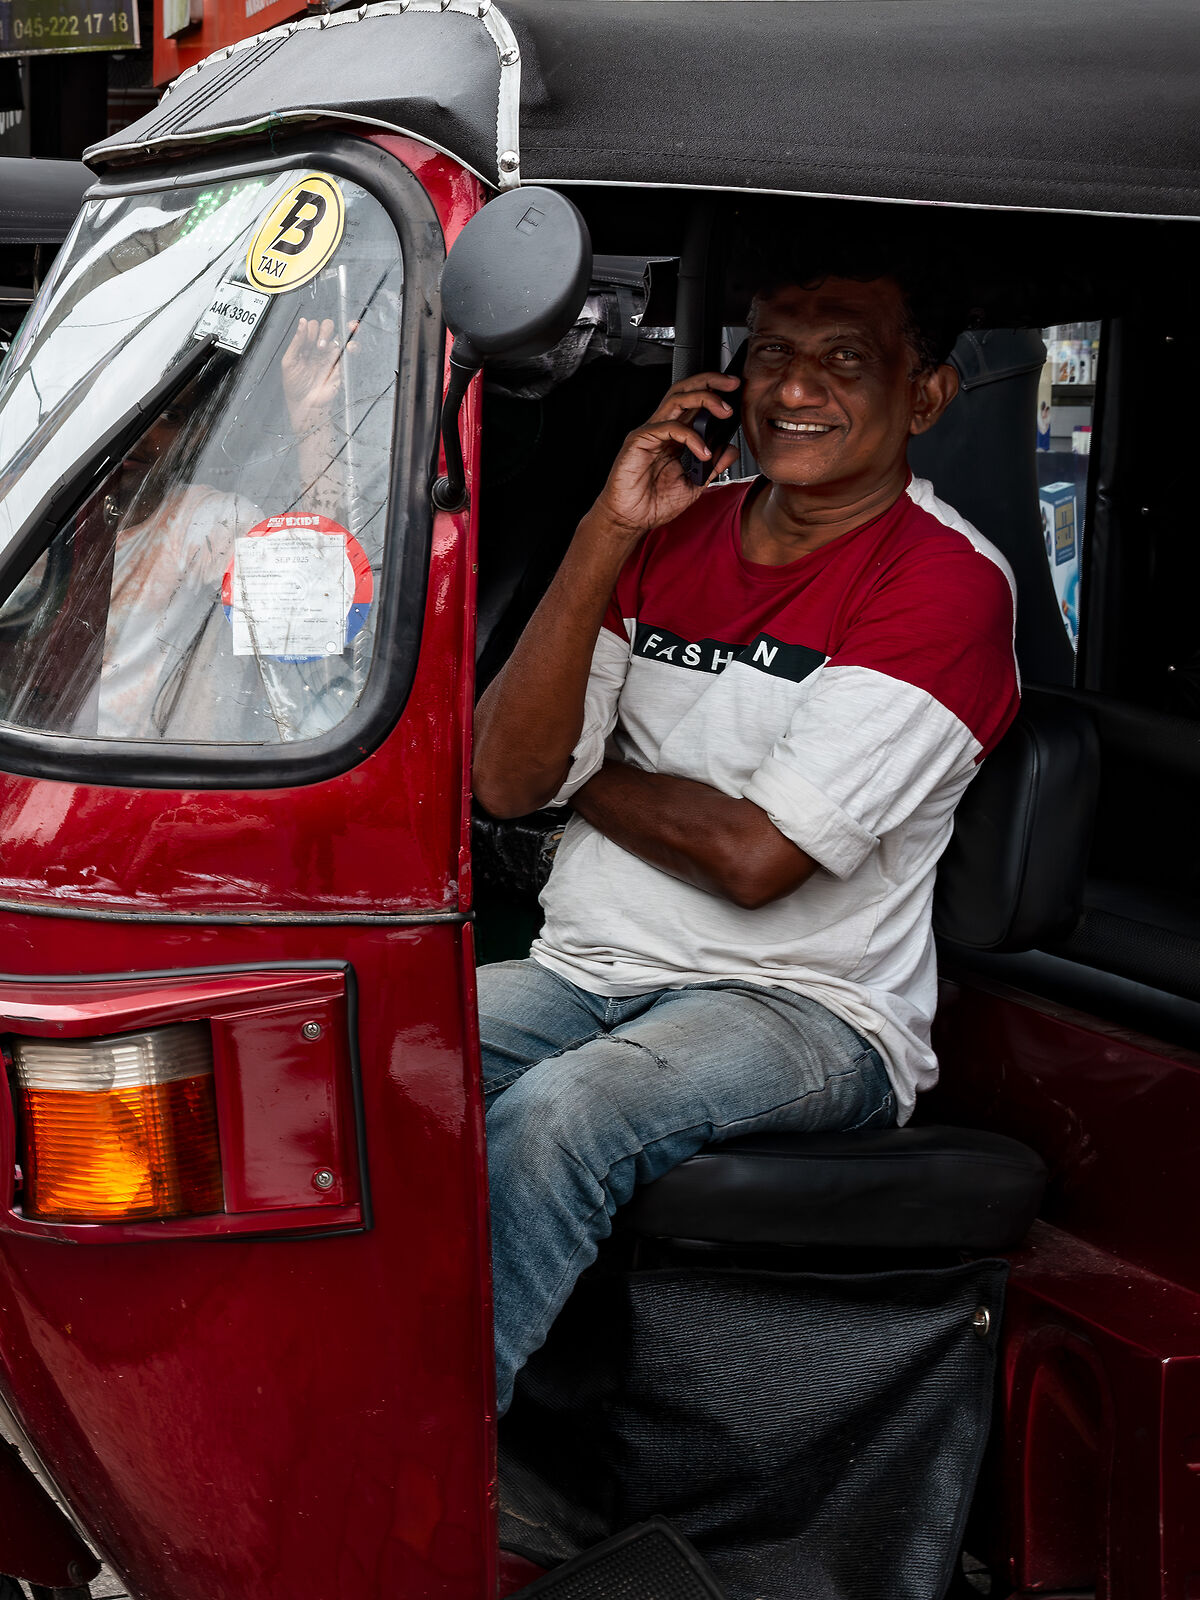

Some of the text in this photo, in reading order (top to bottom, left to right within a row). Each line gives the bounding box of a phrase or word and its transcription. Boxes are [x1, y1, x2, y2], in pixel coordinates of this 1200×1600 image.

[13, 15, 80, 40] 045-222
[84, 13, 104, 34] 17
[108, 12, 129, 33] 18
[263, 190, 327, 256] B
[257, 255, 288, 278] TAXI
[210, 301, 257, 325] AAK 3306
[286, 516, 320, 526] EXIDE
